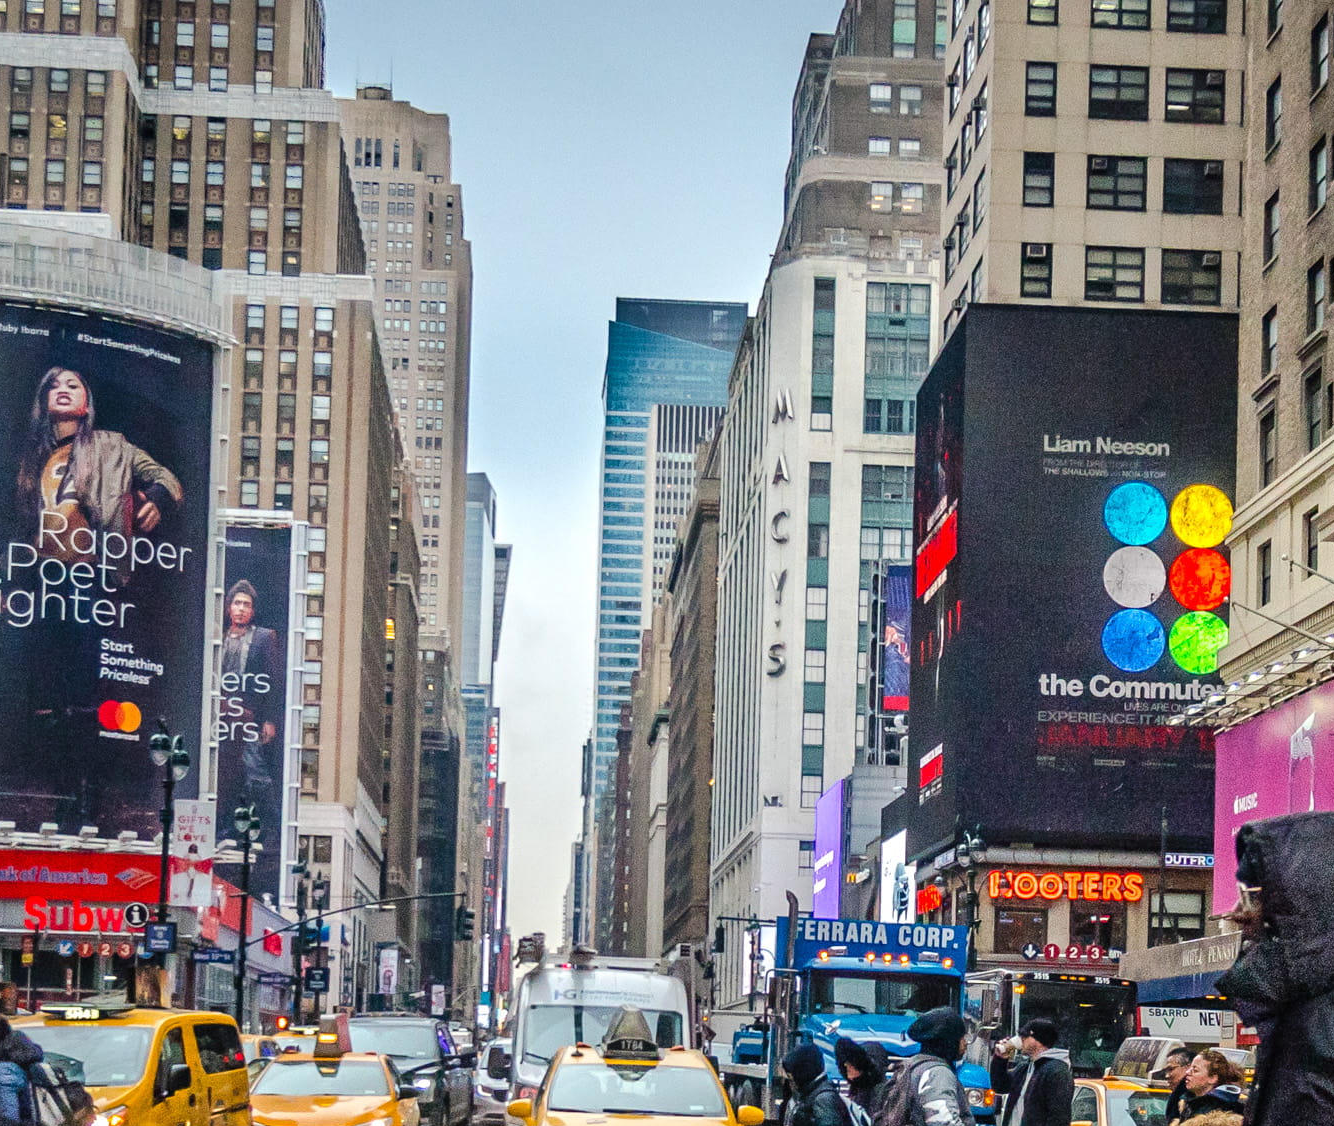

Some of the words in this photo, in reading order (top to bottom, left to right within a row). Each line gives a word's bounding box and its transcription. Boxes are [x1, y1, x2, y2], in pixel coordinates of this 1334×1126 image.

[21, 323, 49, 336] Ibarra
[1043, 434, 1091, 453] Liam
[1095, 436, 1170, 456] Neeson
[1043, 466, 1059, 475] THE
[1062, 467, 1108, 477] SHALLOWS
[39, 509, 192, 572] Rapper
[767, 387, 794, 677] MACY'S
[7, 542, 118, 593] Poet
[100, 638, 134, 654] Start
[99, 653, 164, 675] Something
[98, 667, 151, 685] Priceless
[1038, 673, 1084, 696] the
[1124, 702, 1148, 712] LIVES
[1151, 703, 1170, 712] ARE
[1037, 711, 1135, 724] EXPERIENCE
[1237, 792, 1258, 813] MUSIC
[178, 815, 212, 825] GIFTS
[19, 867, 37, 883] of
[38, 867, 108, 886] America
[988, 870, 1144, 902] HOOTERS
[795, 919, 888, 945] FERRARA
[898, 925, 959, 949] CORP.
[101, 943, 111, 955] 2
[120, 943, 131, 955] 3
[1069, 946, 1079, 958] 2
[1091, 947, 1100, 959] 3
[1148, 1008, 1189, 1018] SBARRO
